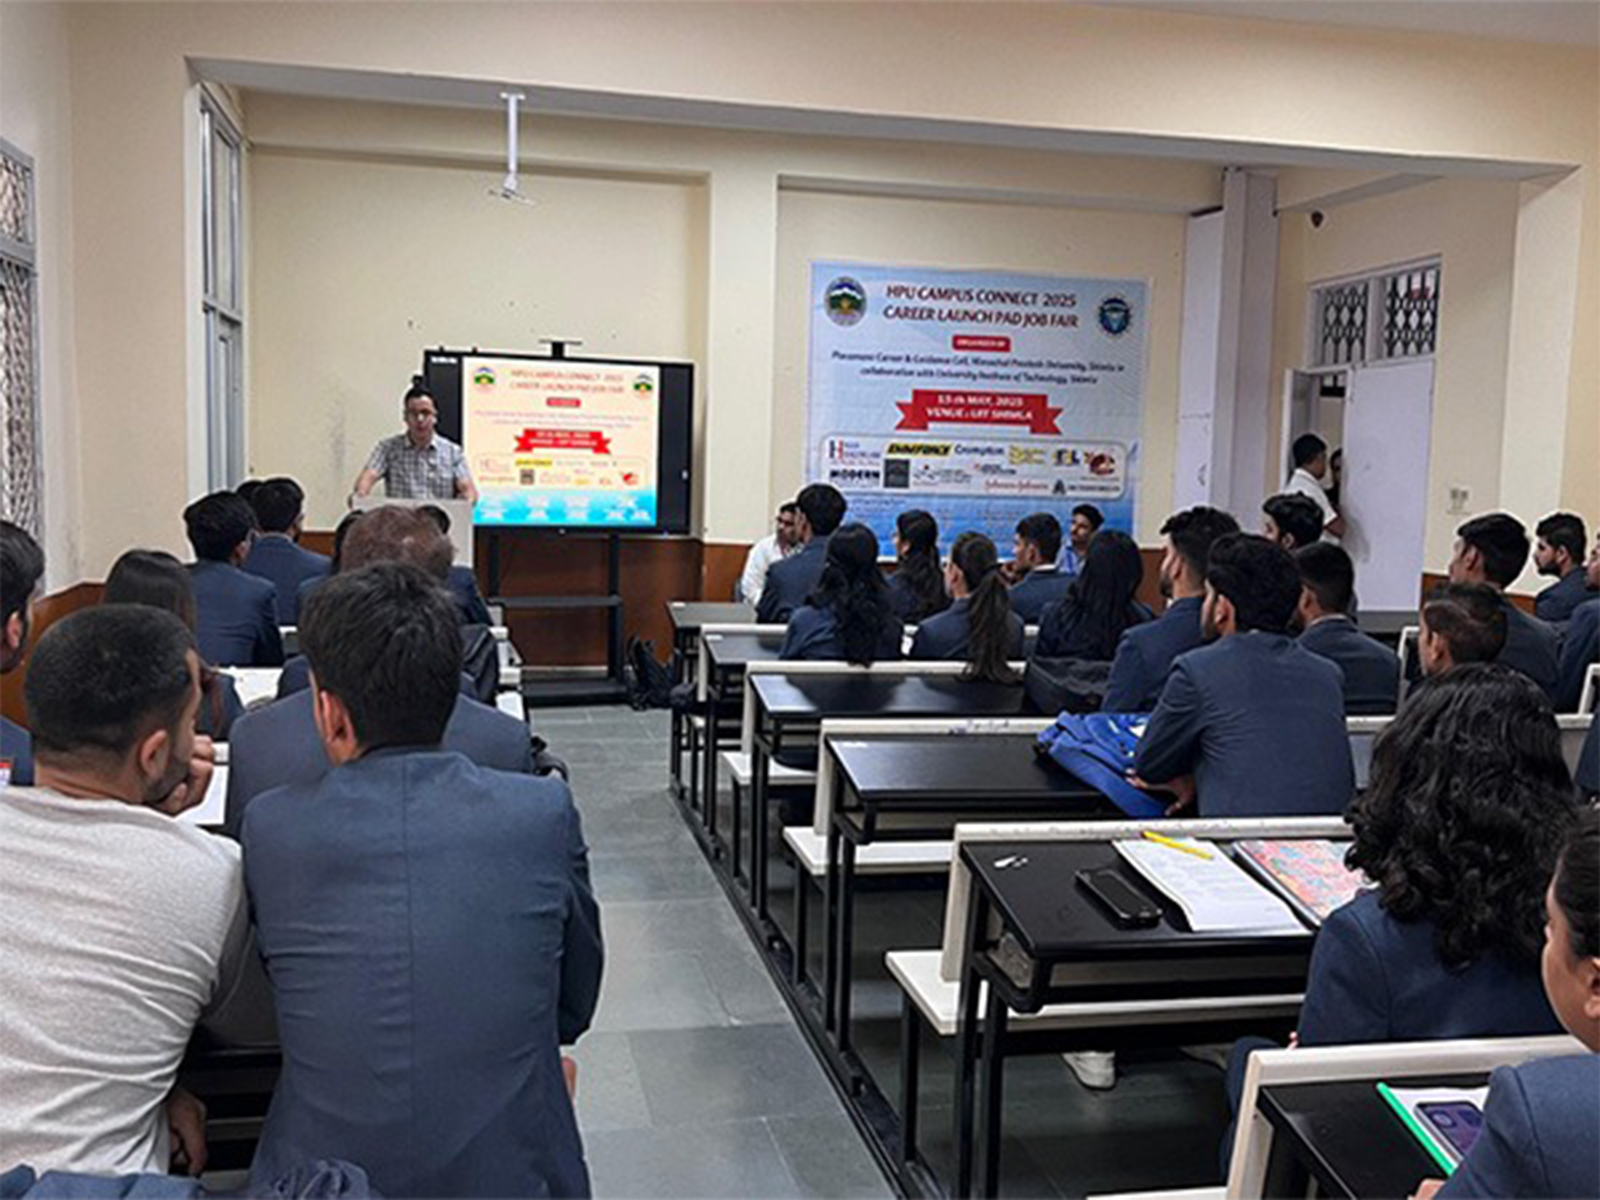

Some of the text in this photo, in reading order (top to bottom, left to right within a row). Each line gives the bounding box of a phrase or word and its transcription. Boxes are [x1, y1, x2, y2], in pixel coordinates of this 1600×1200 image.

[886, 284, 1078, 308] HPU CAMPUS CONNECT 2025
[882, 304, 1079, 328] CAREER LAUNCH PAD JOB FAIR
